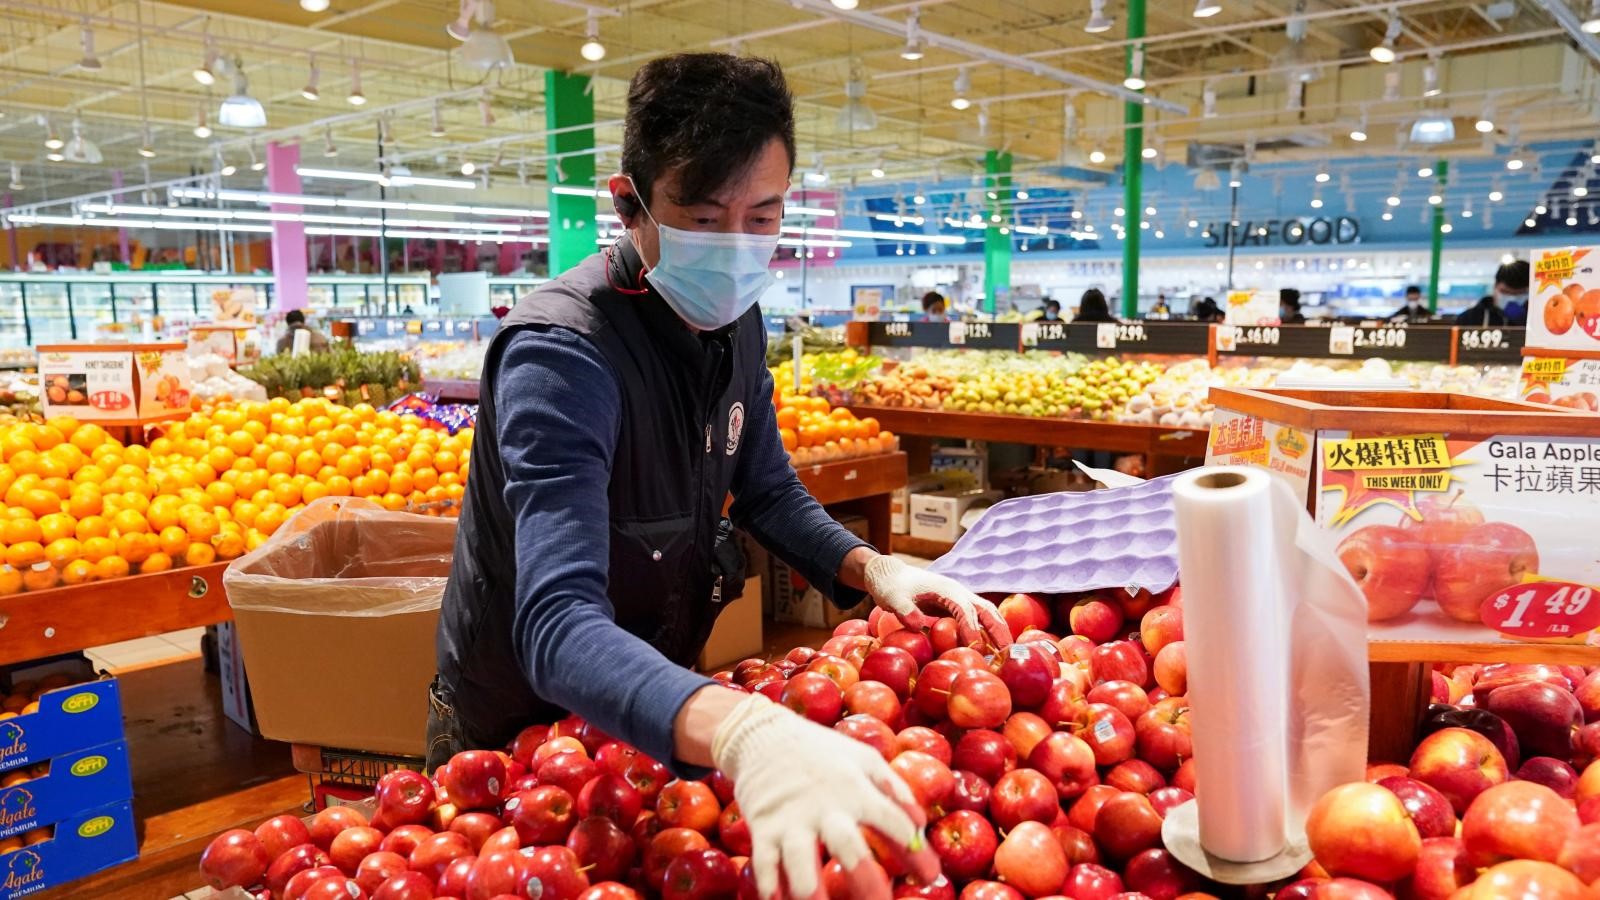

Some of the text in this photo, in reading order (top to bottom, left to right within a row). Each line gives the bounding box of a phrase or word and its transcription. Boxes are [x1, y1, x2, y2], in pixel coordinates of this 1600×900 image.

[1204, 217, 1358, 247] SEAFOOD
[1329, 437, 1440, 468] 火爆特價
[1488, 441, 1536, 459] Gala
[1366, 475, 1443, 489] THIS WEEK ONLY
[1483, 464, 1600, 494] 卡拉蘋果
[0, 737, 28, 762] gate
[0, 820, 38, 837] PREMIUM
[0, 866, 44, 892] Agate
[8, 883, 46, 900] PREMIUM
